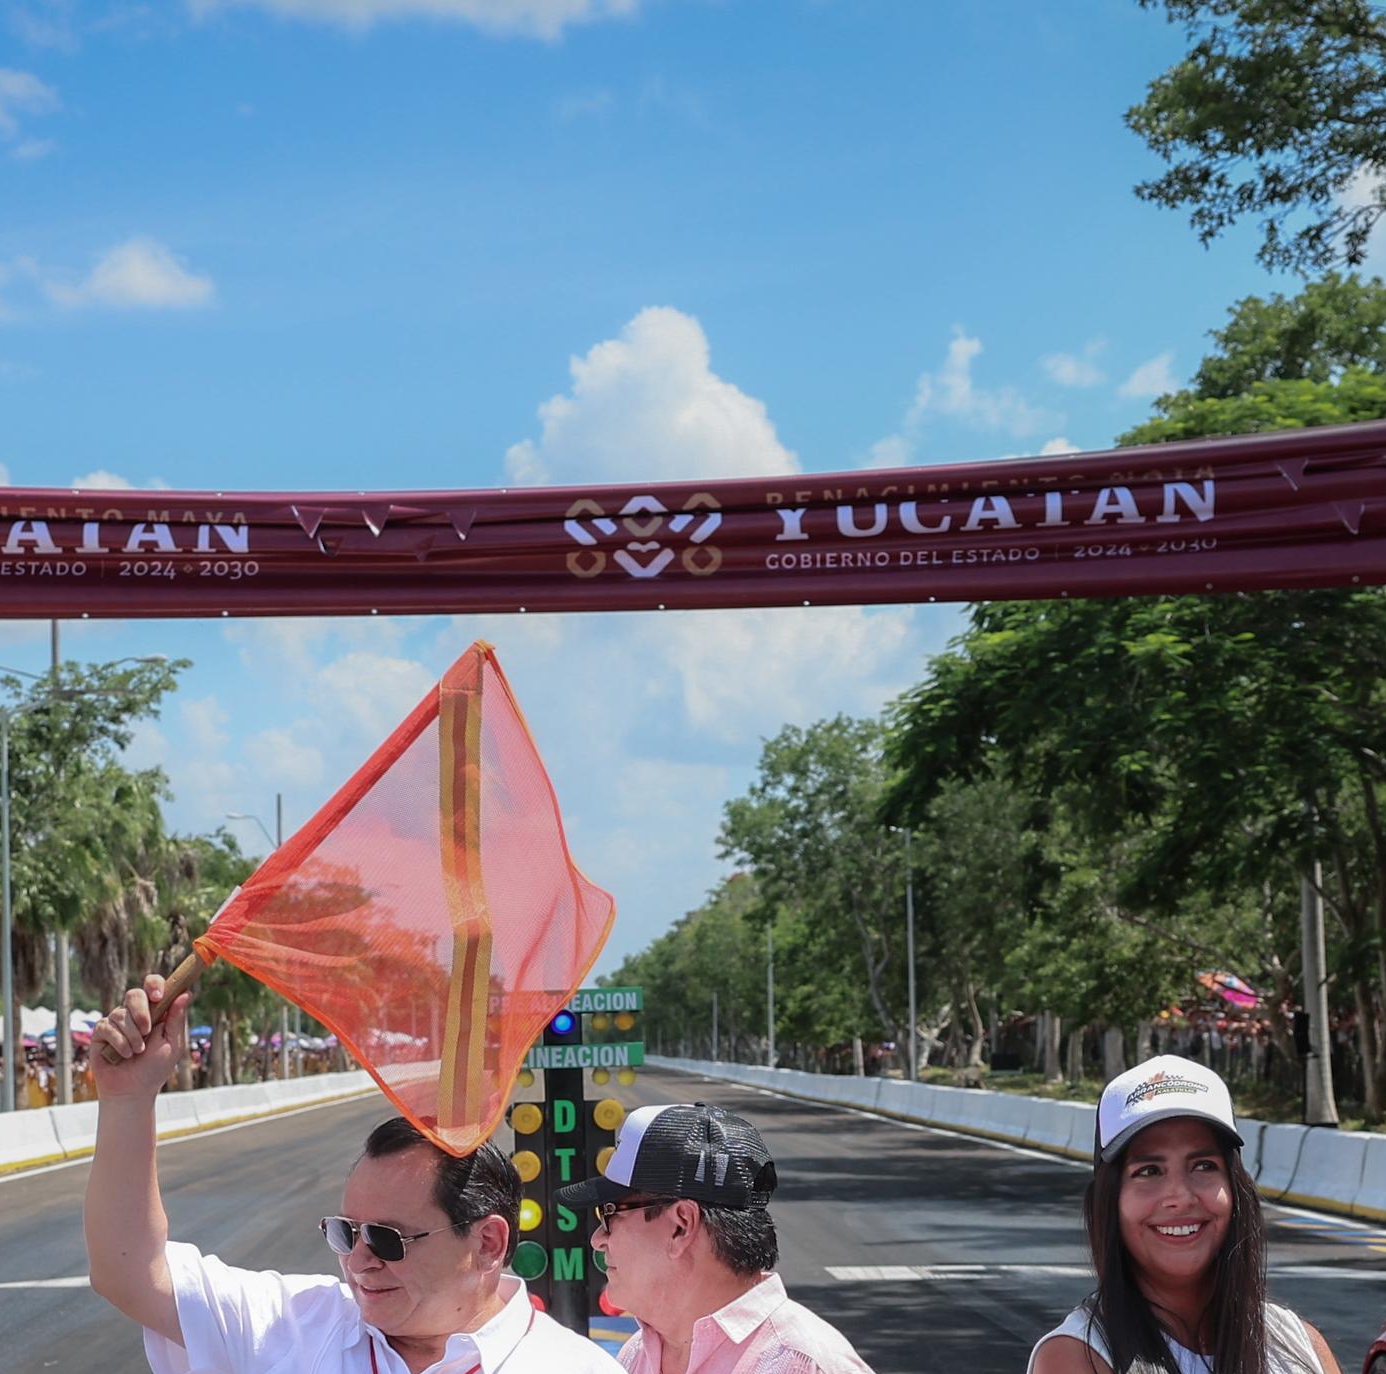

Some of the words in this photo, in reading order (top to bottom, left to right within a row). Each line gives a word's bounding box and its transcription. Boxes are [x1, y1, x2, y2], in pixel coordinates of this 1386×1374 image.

[765, 551, 890, 569] GOBIERNO
[899, 550, 943, 565] DEL
[951, 547, 1040, 564] ESTADO
[0, 561, 87, 576] ESTADO
[119, 560, 177, 579] 2024
[199, 560, 260, 580] 2030
